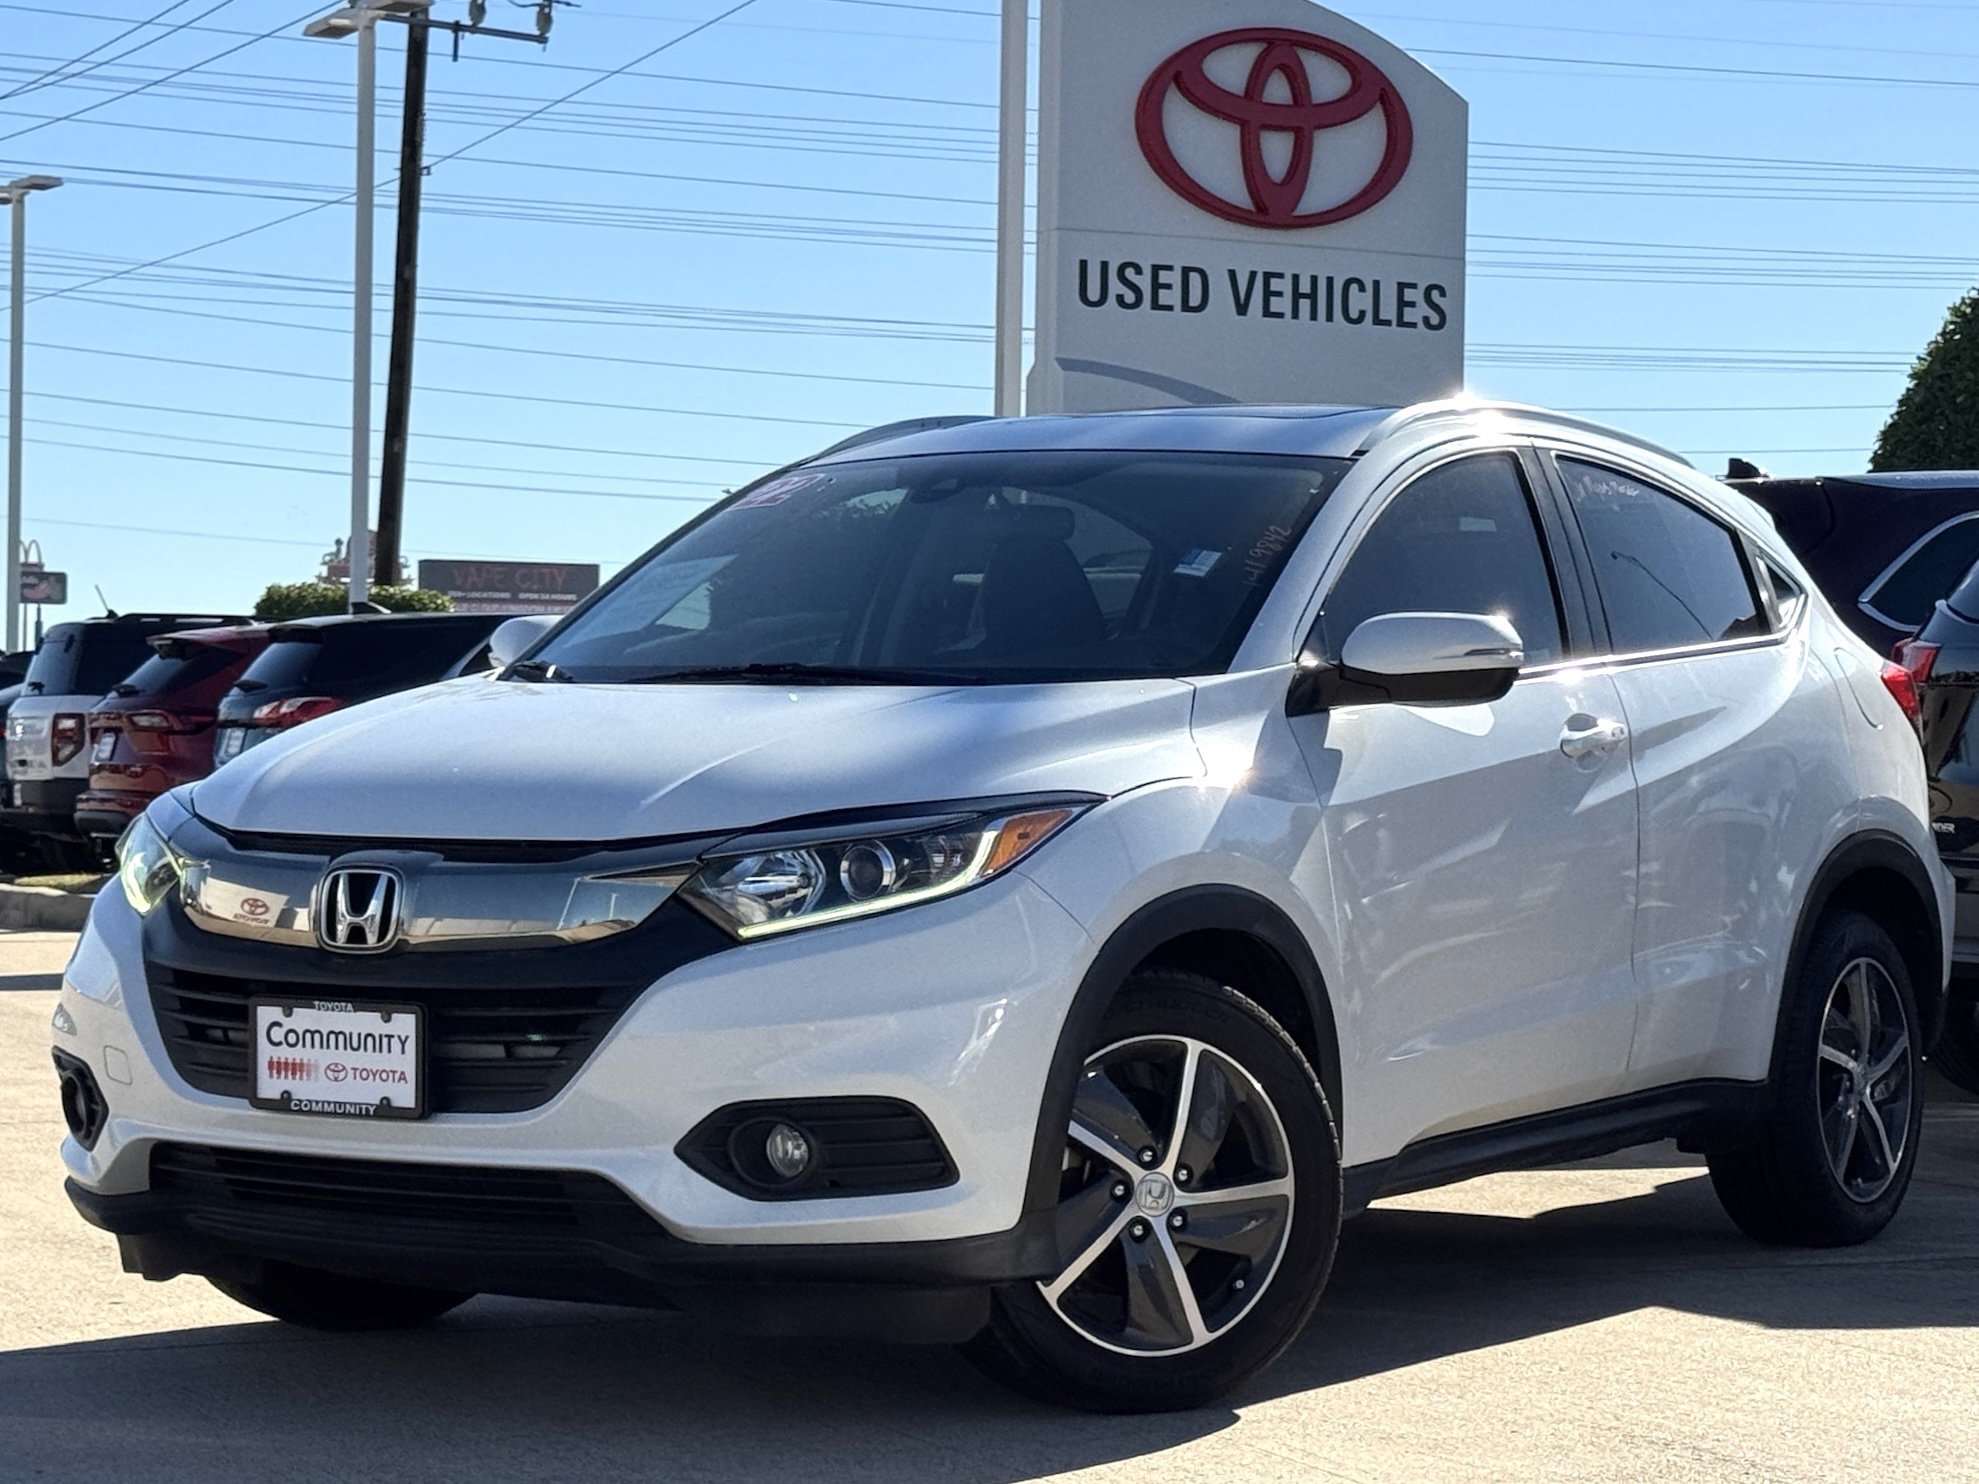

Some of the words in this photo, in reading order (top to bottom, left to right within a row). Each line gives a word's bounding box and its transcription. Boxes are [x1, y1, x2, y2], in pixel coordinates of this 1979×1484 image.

[1078, 258, 1210, 314] USED
[1227, 268, 1448, 331] VEHICLES
[515, 567, 567, 591] CITY
[313, 1000, 355, 1013] TOYOTA
[351, 1066, 409, 1084] TOYOTA
[290, 1100, 378, 1116] COMMUNITY
